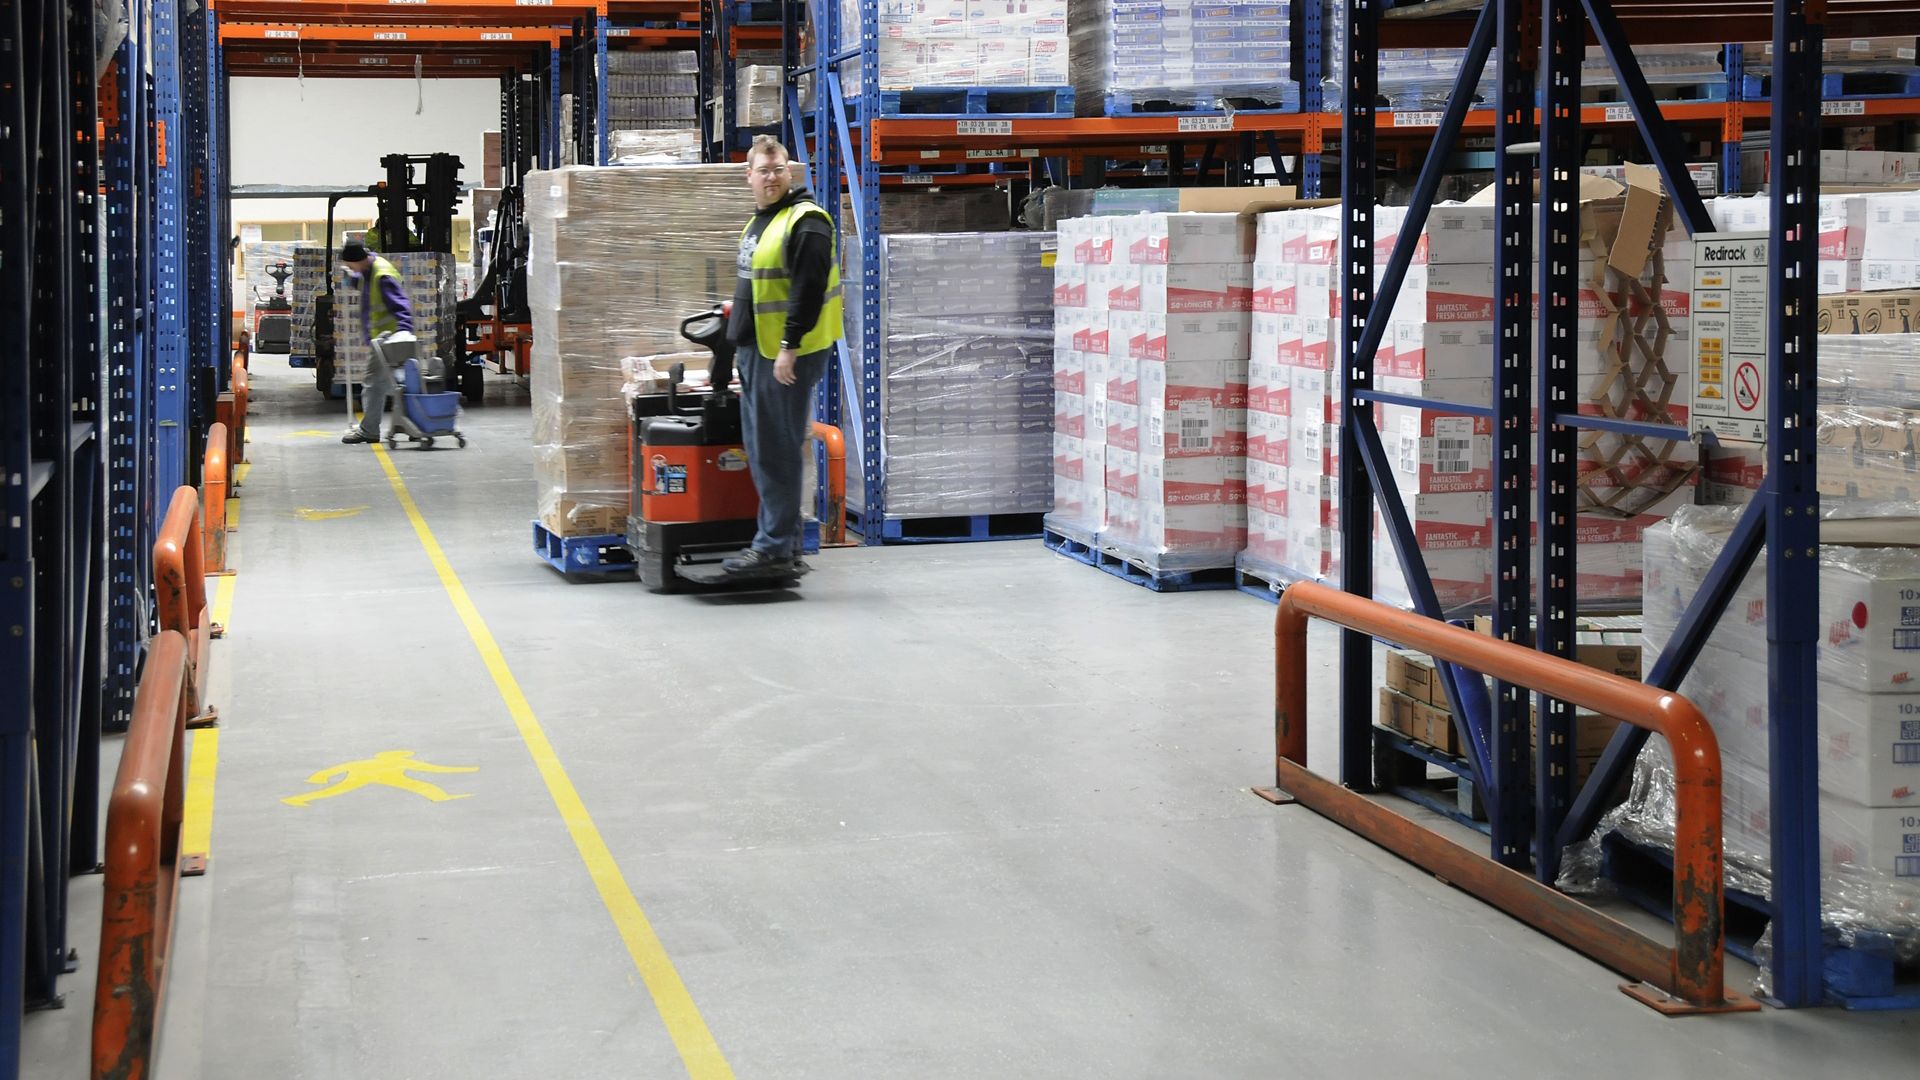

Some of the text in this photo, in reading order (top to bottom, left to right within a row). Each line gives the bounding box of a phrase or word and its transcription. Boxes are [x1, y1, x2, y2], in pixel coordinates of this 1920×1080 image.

[1704, 244, 1746, 261] Redirack
[1184, 300, 1213, 309] LONGER
[1436, 303, 1468, 313] FANTASTIC
[1436, 311, 1479, 320] FRESH SCENTS
[1665, 307, 1687, 316] SCENTS
[1430, 475, 1462, 484] FANTASTIC
[1429, 482, 1473, 492] FRESH SCENTS
[1181, 492, 1210, 501] LONGER
[1425, 532, 1458, 541] FANTASTIC
[1425, 540, 1469, 549] FRESH SCENTS
[1899, 589, 1914, 601] 10
[1829, 619, 1851, 647] AJAX
[1899, 704, 1913, 714] 10
[1900, 817, 1915, 828] 10
